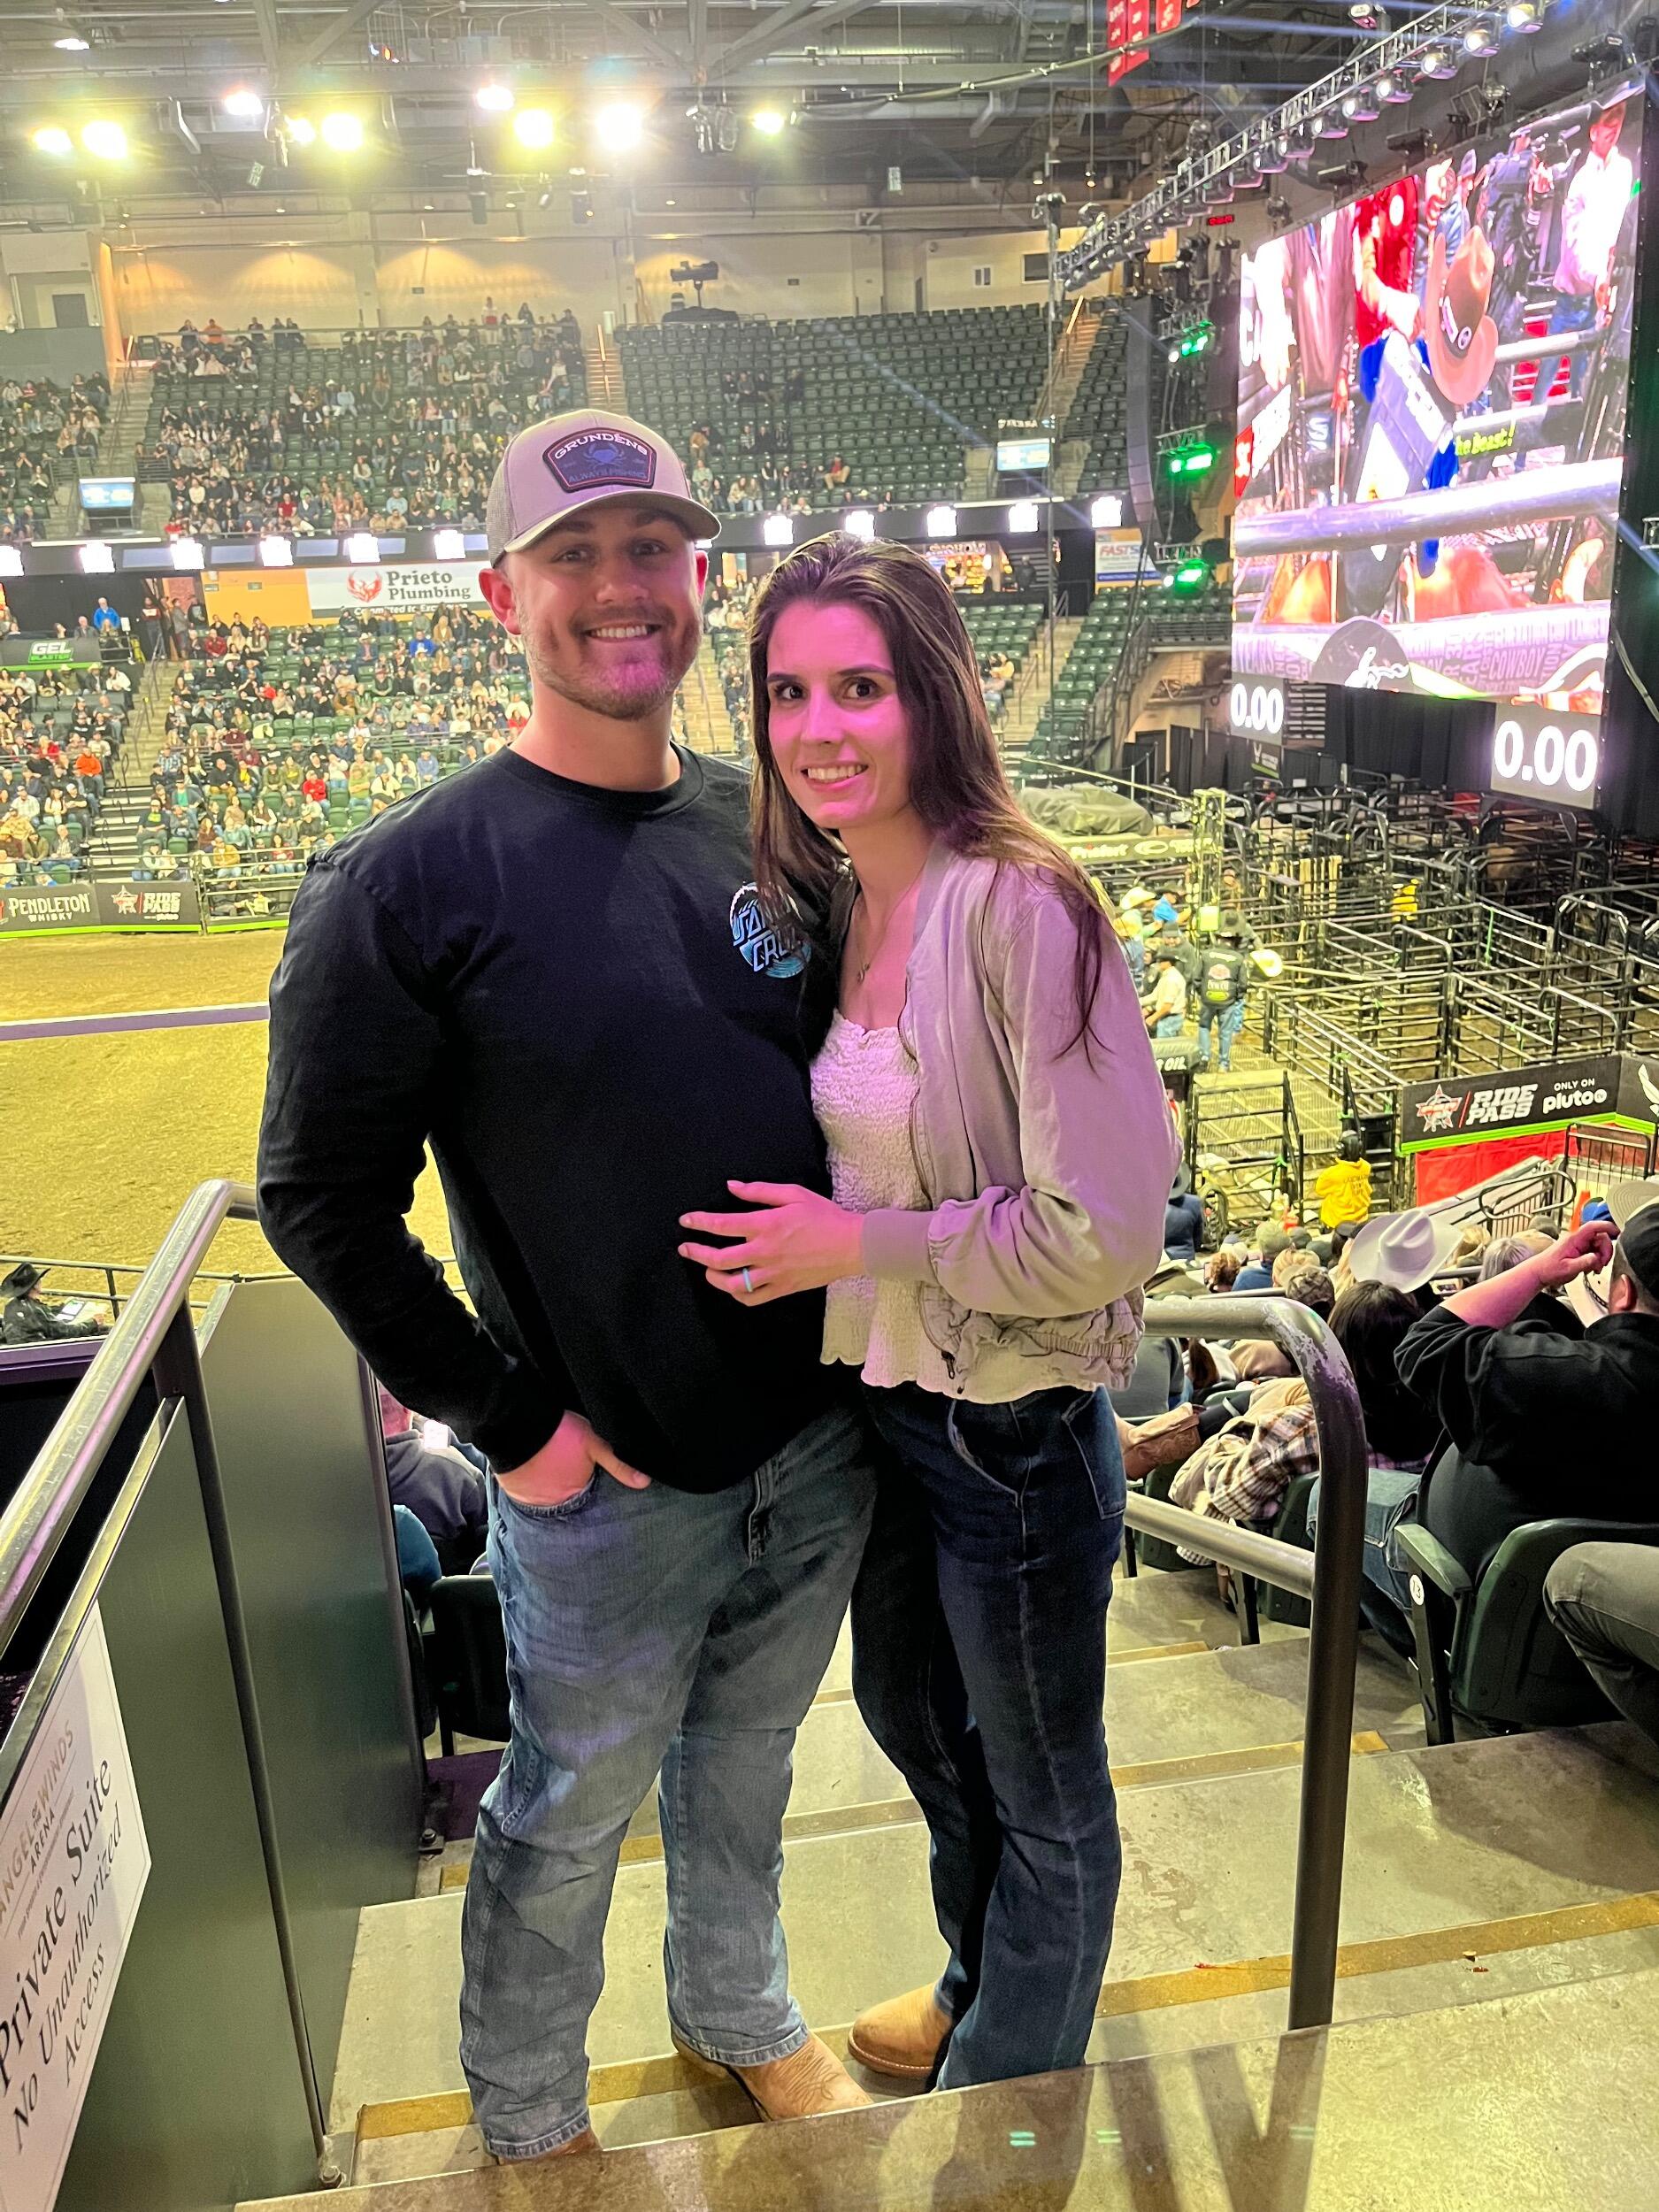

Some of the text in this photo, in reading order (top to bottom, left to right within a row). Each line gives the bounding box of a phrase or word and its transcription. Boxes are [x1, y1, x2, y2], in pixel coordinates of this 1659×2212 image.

[387, 570, 453, 587] Prieto
[388, 587, 472, 601] Plumbing
[32, 641, 71, 655] GEL
[1231, 683, 1285, 733] 0.00
[1494, 720, 1597, 792] 0.00
[9, 894, 90, 918] PENDLETON
[142, 902, 180, 913] PASS
[143, 892, 181, 903] RIDE
[28, 913, 73, 923] WHISKY
[1471, 1084, 1538, 1108] RIDE
[1554, 1078, 1594, 1091] ONLY ON
[1465, 1101, 1532, 1125] PASS
[37, 1719, 73, 1810] WINDS
[30, 1807, 55, 1874] ARENA
[0, 1886, 66, 2097] Private
[66, 1759, 111, 1886] Suite
[13, 2071, 38, 2154] No
[39, 1801, 121, 2065] Unauthorized
[65, 1942, 104, 2088] Access
